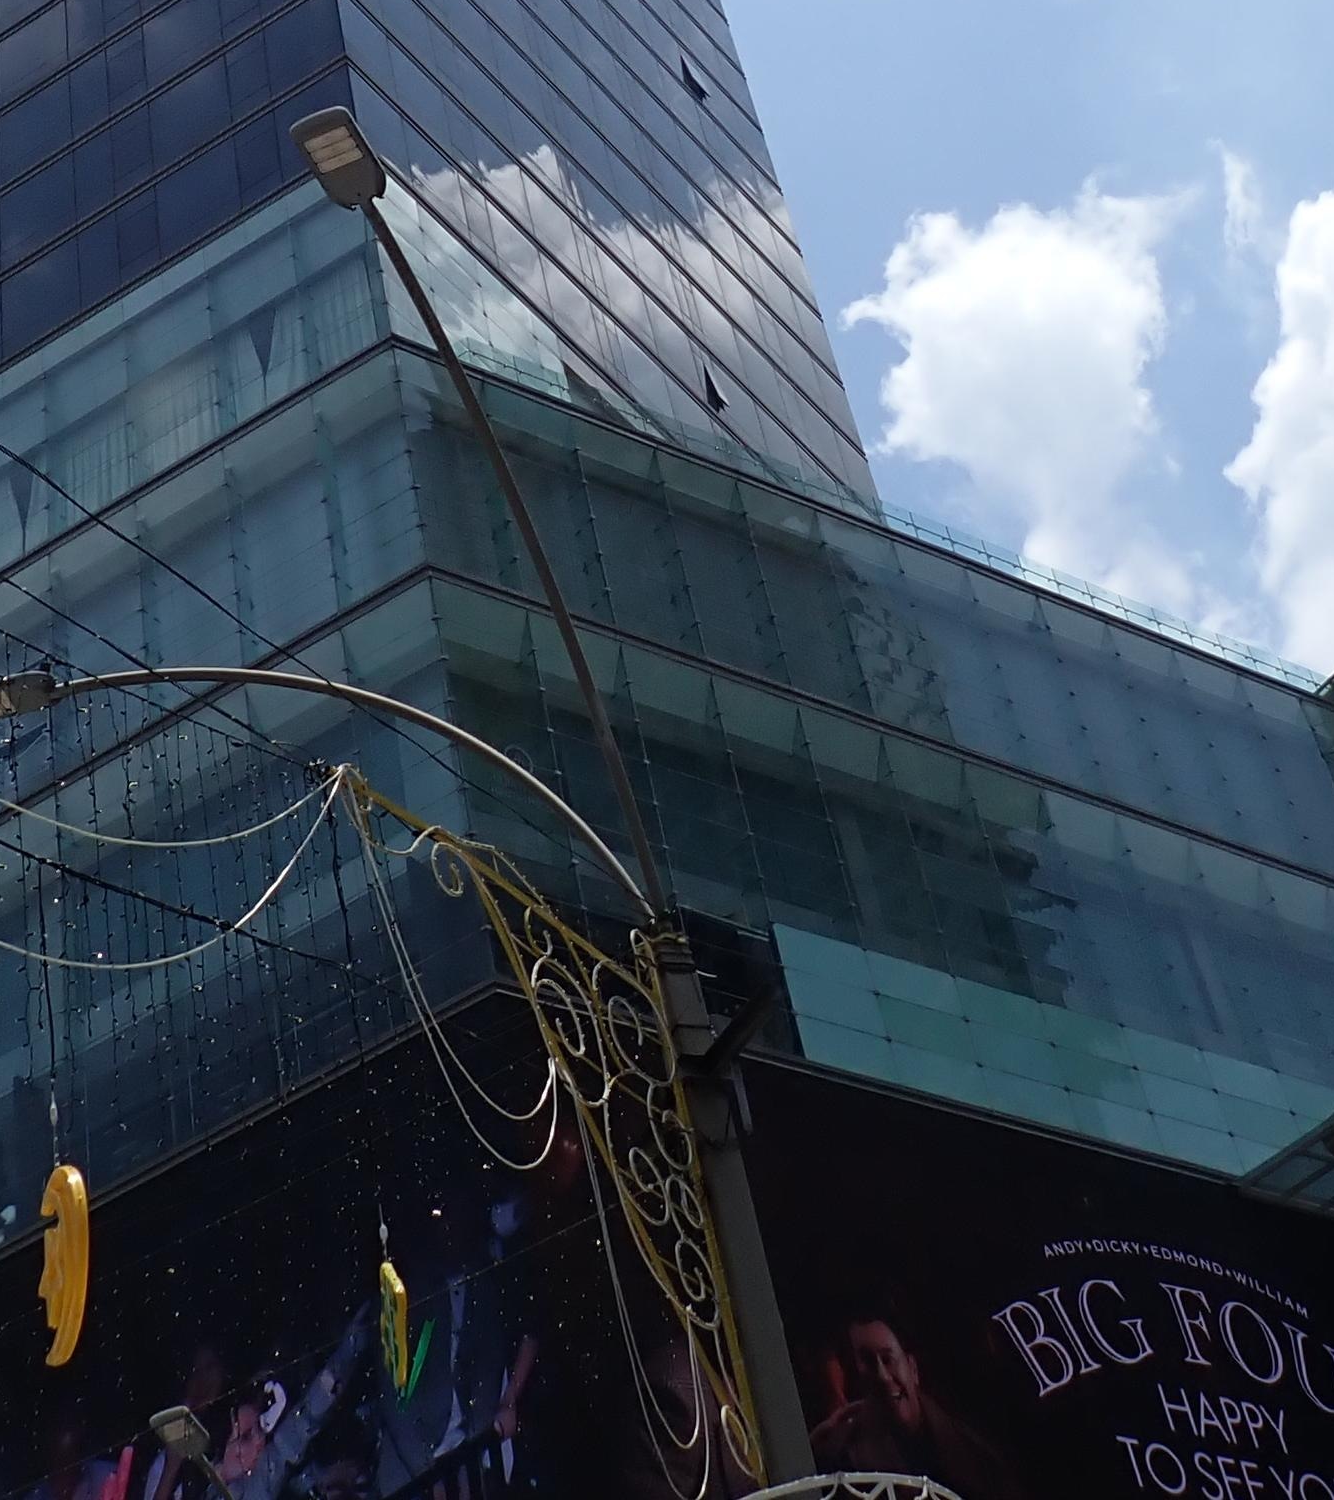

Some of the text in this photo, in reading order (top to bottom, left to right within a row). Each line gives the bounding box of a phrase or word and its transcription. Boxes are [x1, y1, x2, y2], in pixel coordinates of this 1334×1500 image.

[1043, 1238, 1310, 1319] ANDY DICKY EDMOND WILLIAM
[991, 1278, 1155, 1397] BIG
[1157, 1382, 1290, 1455] HAPPY
[1115, 1435, 1187, 1495] TO
[1193, 1451, 1265, 1500] SEE
